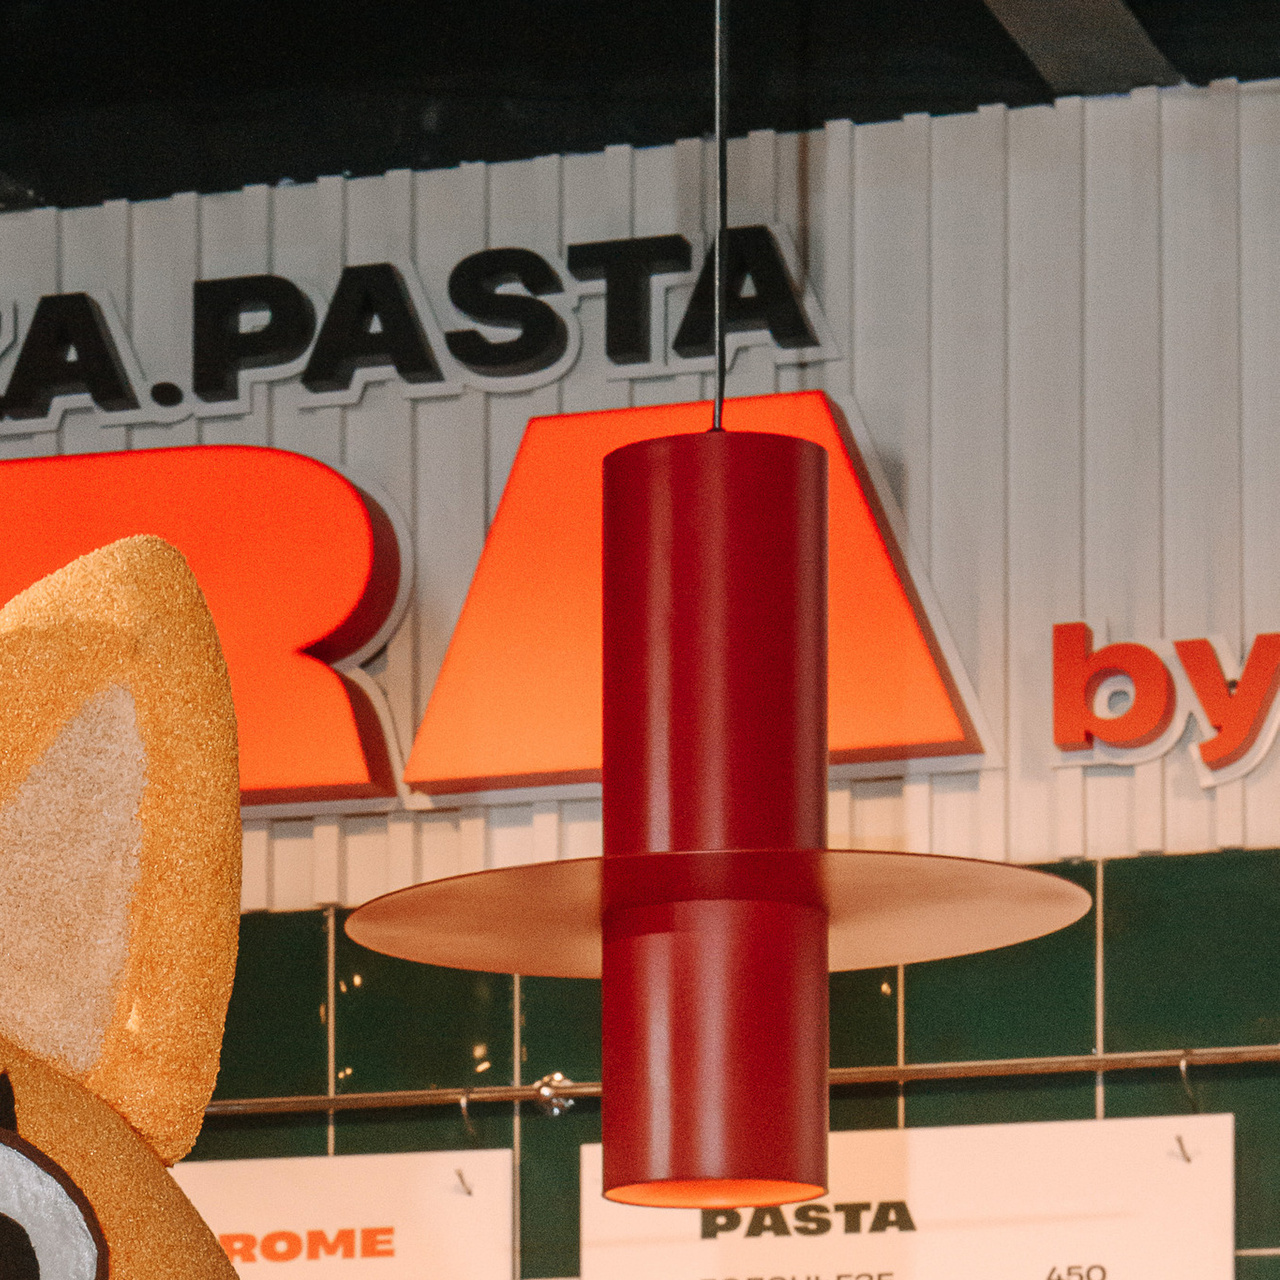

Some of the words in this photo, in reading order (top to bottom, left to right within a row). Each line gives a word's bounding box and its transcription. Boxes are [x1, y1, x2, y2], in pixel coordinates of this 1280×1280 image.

[1051, 621, 1280, 771] by
[700, 1200, 917, 1240] PASTA
[220, 1226, 396, 1264] ROME
